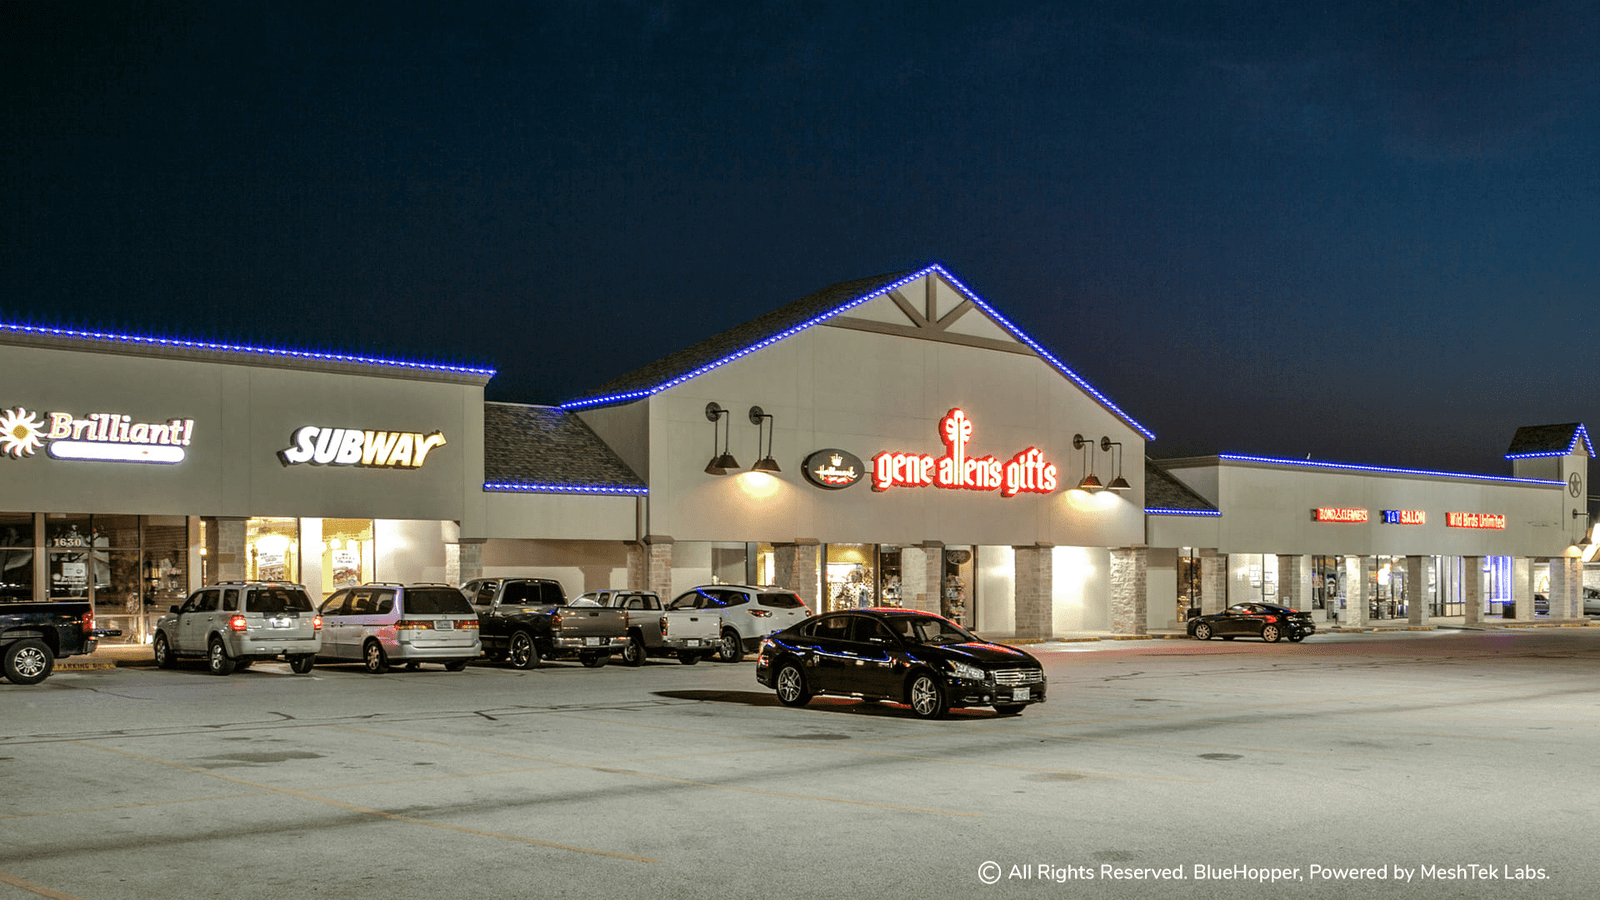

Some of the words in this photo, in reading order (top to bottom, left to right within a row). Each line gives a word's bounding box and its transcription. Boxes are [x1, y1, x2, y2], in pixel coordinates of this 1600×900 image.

[47, 411, 195, 446] Brilliant!
[284, 425, 447, 468] SUBWAY
[877, 452, 935, 489] gene
[938, 409, 1003, 488] allen's
[1006, 447, 1057, 494] gifts
[1400, 509, 1426, 524] SALON
[1449, 511, 1462, 527] Wild
[1463, 512, 1479, 528] Birds
[1479, 513, 1506, 530] Unlimited
[53, 538, 82, 547] 1630
